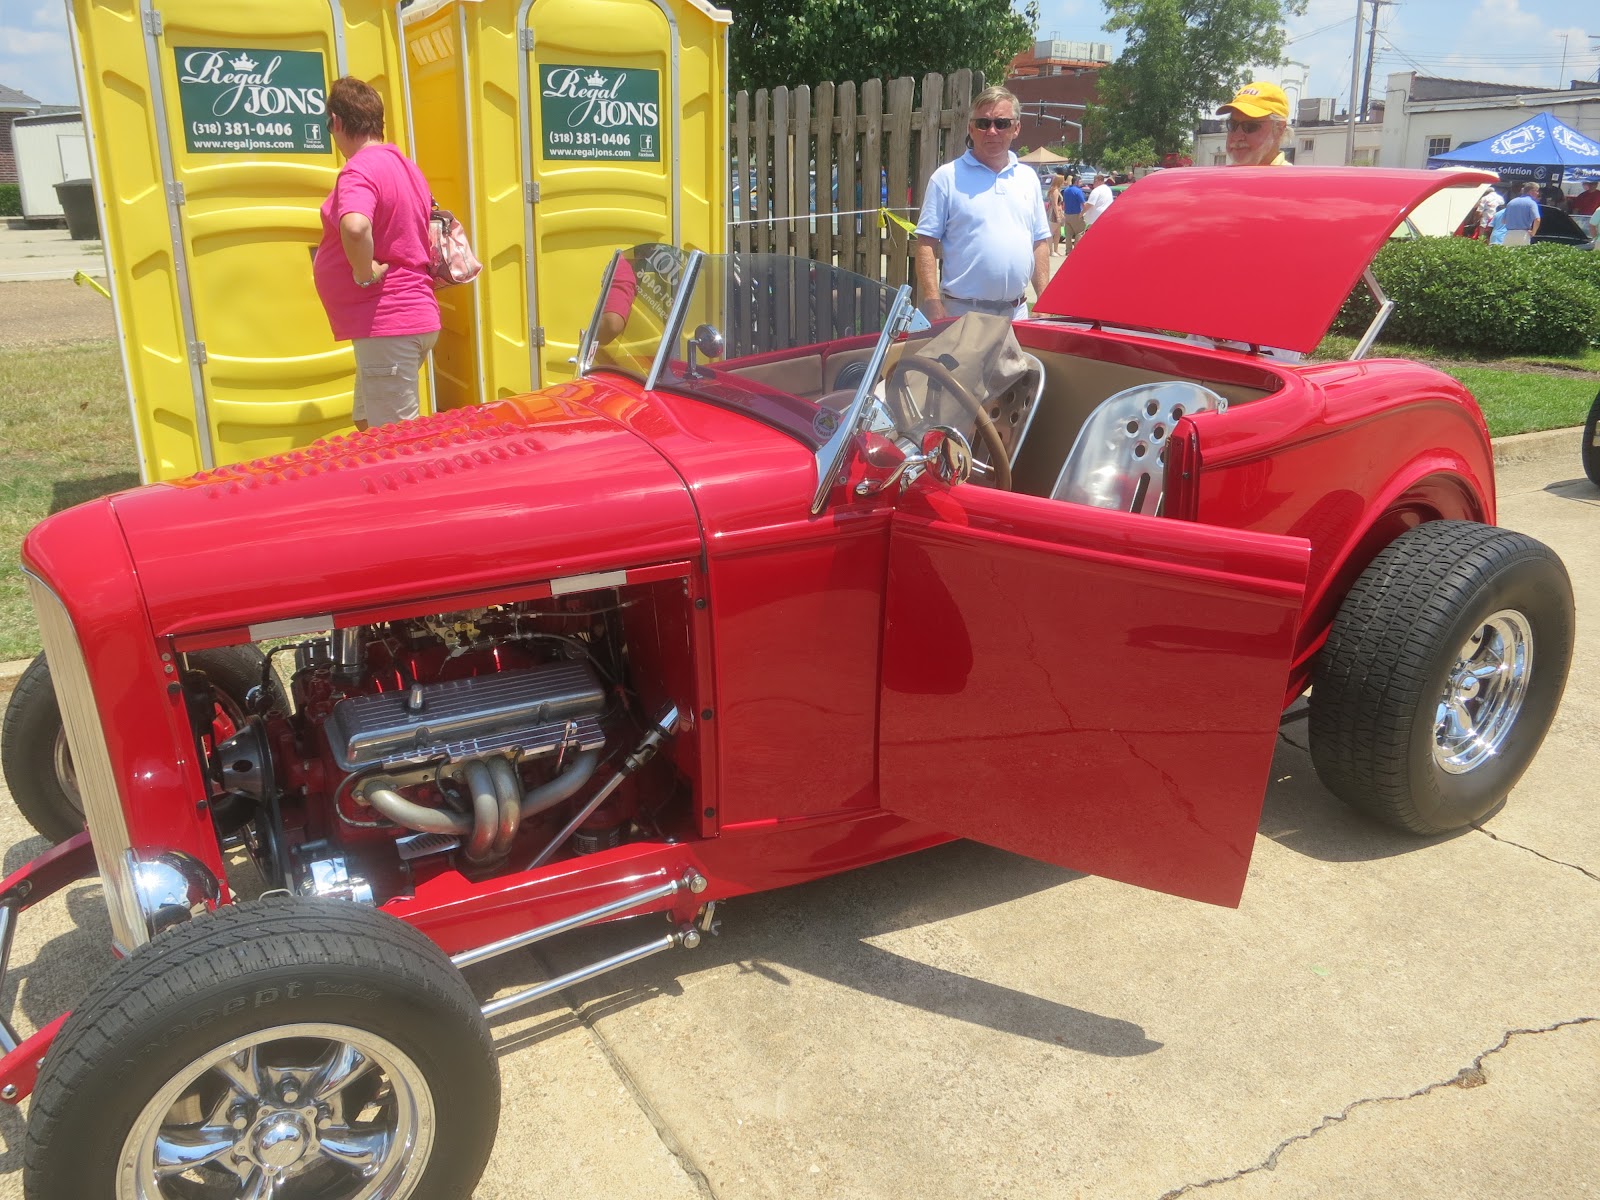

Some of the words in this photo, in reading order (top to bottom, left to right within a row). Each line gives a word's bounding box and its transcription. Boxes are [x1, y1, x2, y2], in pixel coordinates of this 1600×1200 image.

[181, 51, 282, 116] Regal
[244, 87, 326, 115] JONS
[543, 68, 627, 127] Regal
[594, 101, 658, 126] JONS
[193, 121, 221, 135] (318)
[225, 122, 293, 136] 381-0406
[194, 138, 294, 150] www.regaljons.com
[549, 131, 574, 145] (318)
[576, 132, 631, 145] 381-0406
[549, 148, 631, 158] www.regaljons.com
[1498, 166, 1532, 176] Solution
